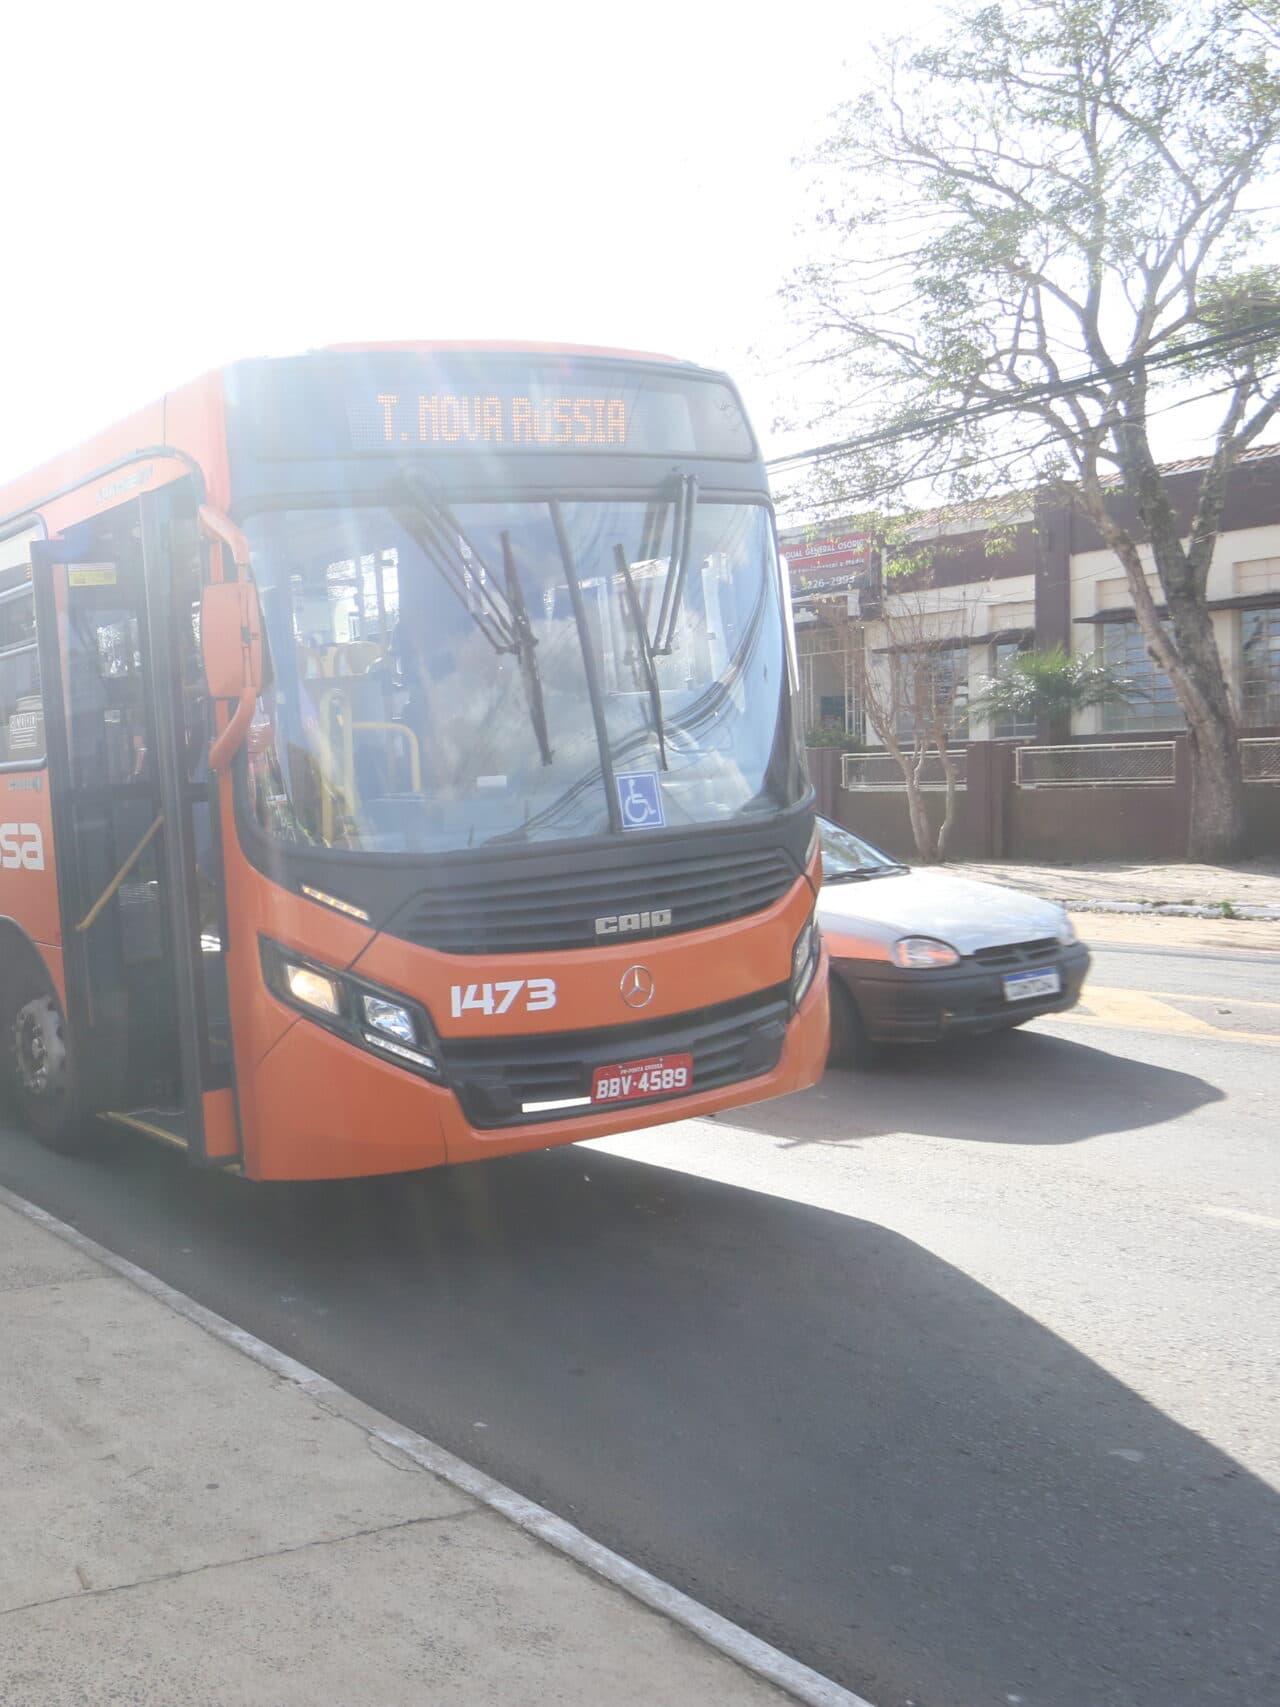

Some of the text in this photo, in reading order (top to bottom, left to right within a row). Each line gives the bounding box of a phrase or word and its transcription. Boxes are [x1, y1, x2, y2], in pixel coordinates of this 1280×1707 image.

[377, 393, 625, 443] T. NOVA RUSSIA
[595, 909, 671, 935] CAIO
[451, 978, 556, 1018] 1473
